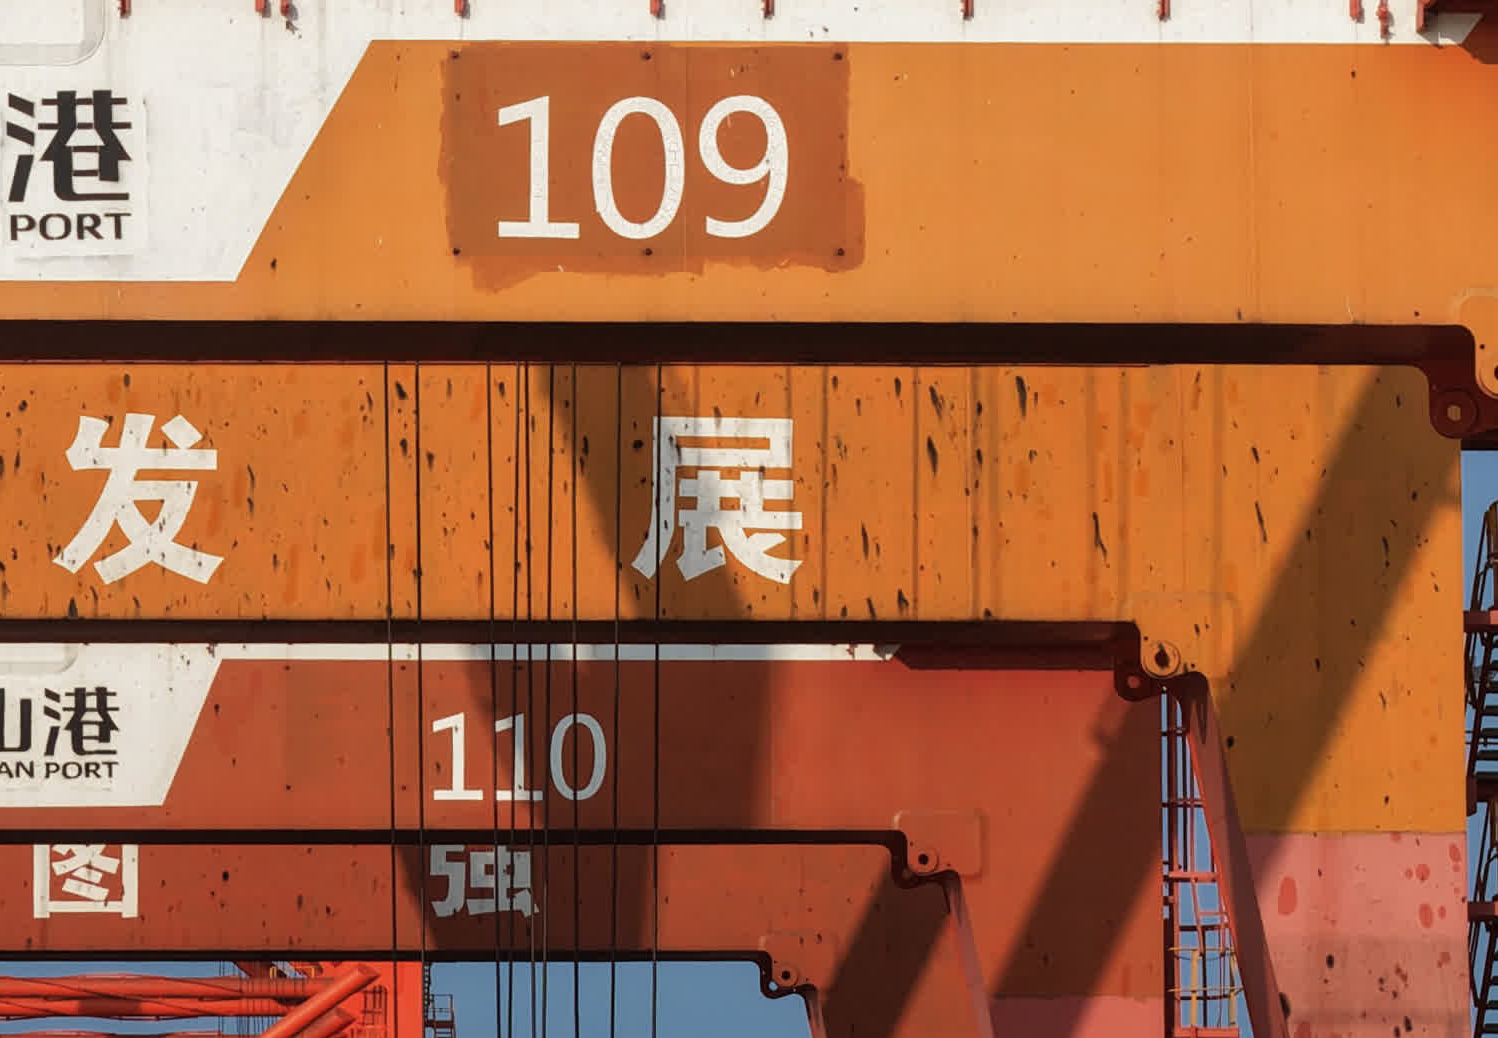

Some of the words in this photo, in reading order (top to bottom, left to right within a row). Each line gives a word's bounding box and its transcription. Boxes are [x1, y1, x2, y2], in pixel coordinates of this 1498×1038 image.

[499, 96, 788, 239] 109
[11, 213, 131, 240] PORT
[45, 762, 118, 779] PORT
[433, 712, 606, 801] 110
